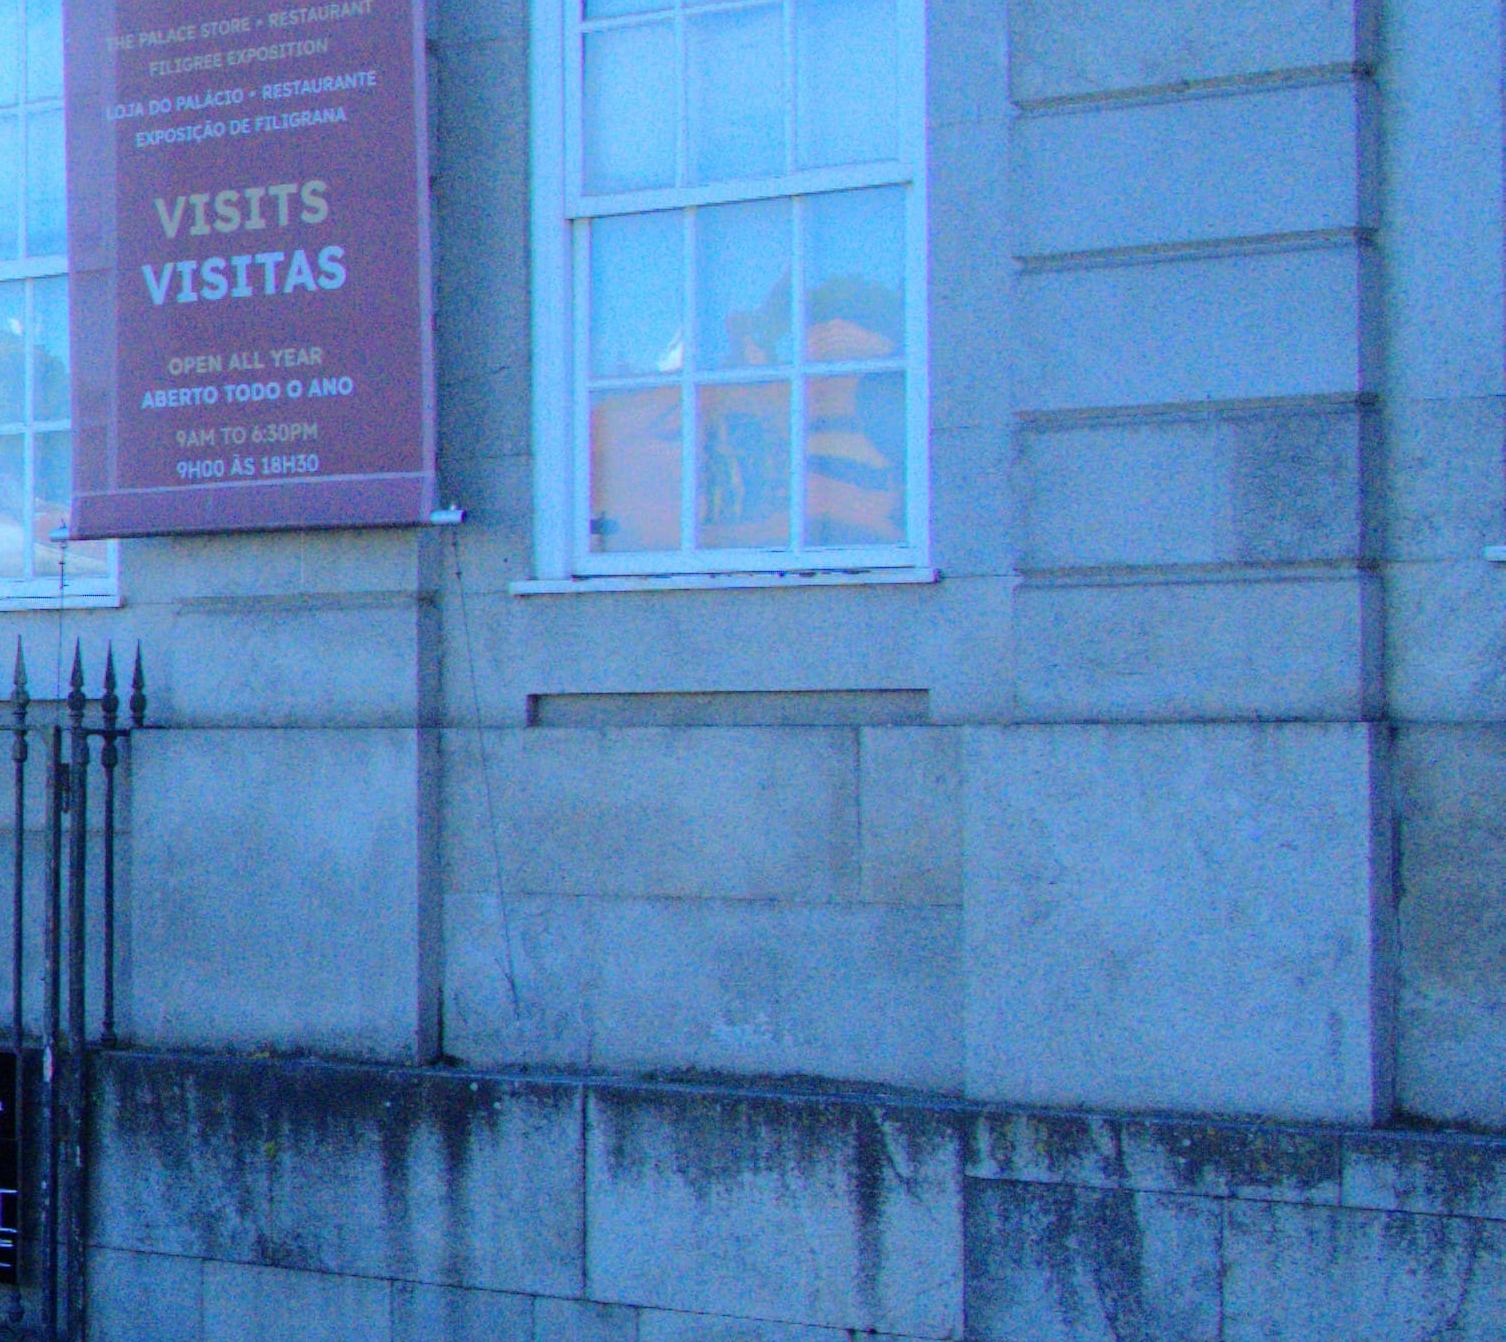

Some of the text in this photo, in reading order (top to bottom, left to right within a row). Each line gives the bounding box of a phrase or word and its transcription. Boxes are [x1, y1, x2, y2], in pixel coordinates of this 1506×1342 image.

[106, 33, 135, 52] THE
[139, 24, 196, 48] PALACE
[200, 17, 251, 39] STORE
[149, 38, 328, 77] FILIGREE EXPOSITION
[106, 70, 377, 121] LOJA DO PALÁCIO RESTAURANTE
[135, 106, 346, 147] EXPOSIÇÃO DE FILIGRANA
[154, 180, 329, 238] VISITS
[141, 245, 347, 305] VISITAS
[168, 346, 323, 376] OPEN ALL YEAR
[141, 376, 354, 409] ABERTO TODO O ANO
[176, 422, 318, 447] 9AM TO 6:30PM
[176, 459, 224, 479] 9H00
[261, 454, 319, 475] 18H30
